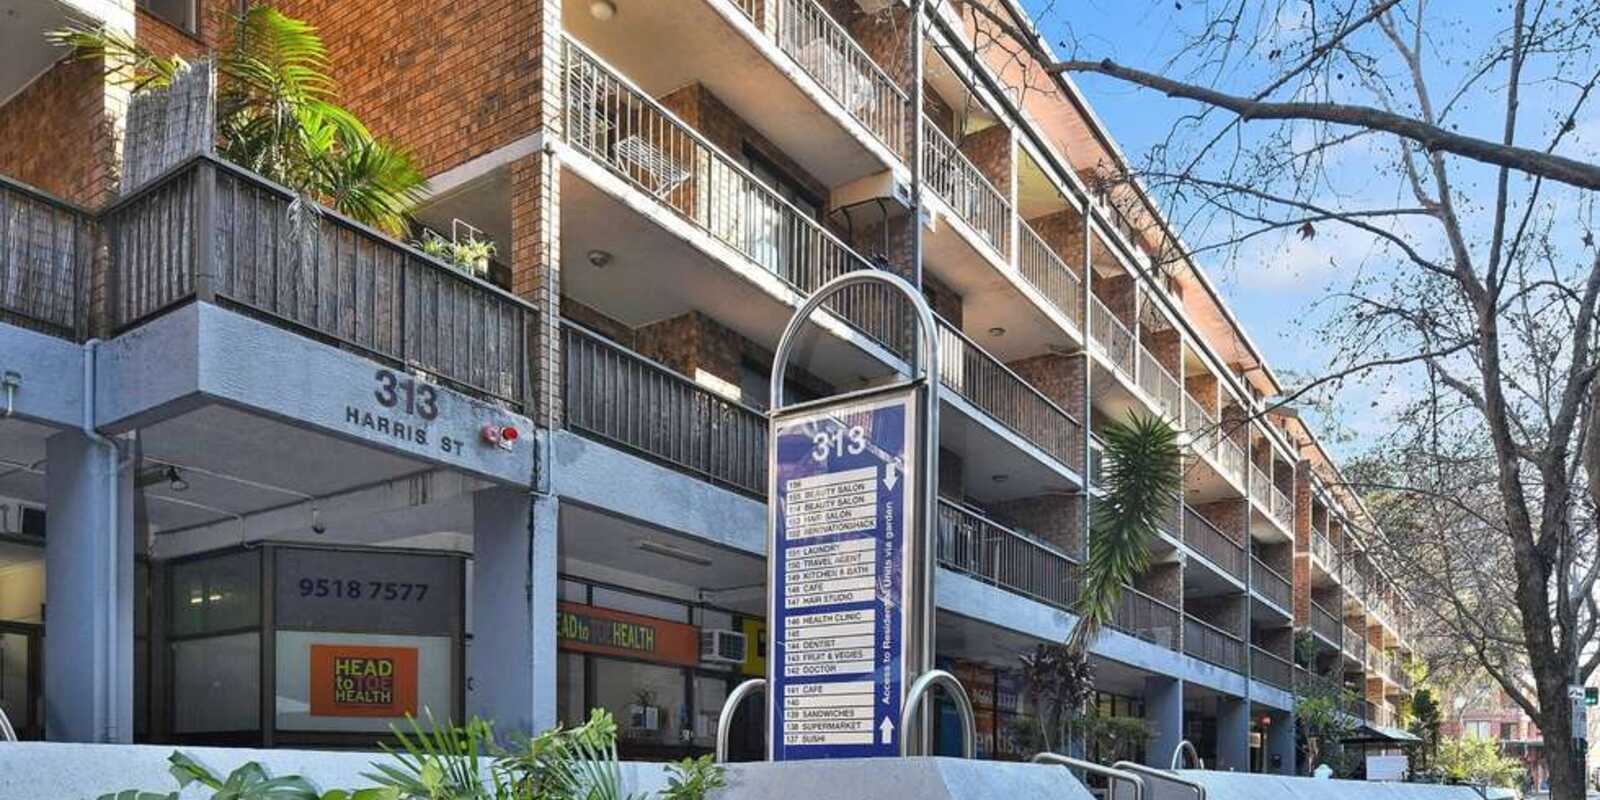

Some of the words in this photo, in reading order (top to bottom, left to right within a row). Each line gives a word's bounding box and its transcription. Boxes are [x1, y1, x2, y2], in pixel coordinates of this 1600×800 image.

[374, 369, 438, 421] 313
[346, 406, 427, 445] HARRIS
[441, 436, 465, 455] ST
[812, 426, 865, 461] 313
[805, 488, 836, 499] BEAUTY
[838, 483, 865, 492] SALON
[805, 500, 836, 511] BEAUTY
[838, 496, 865, 506] SALON
[826, 510, 852, 519] SALON
[885, 501, 894, 539] garden
[803, 544, 840, 556] LAUNDRY
[803, 558, 833, 567] TRAVEL
[834, 553, 861, 563] AGENT
[803, 569, 838, 579] KITCHEN
[847, 566, 869, 576] BATH
[884, 560, 892, 587] Units
[300, 578, 361, 599] 9518
[369, 582, 429, 601] 7577
[803, 583, 824, 592] CAFE
[803, 595, 822, 604] HAIR
[823, 592, 853, 602] STUDIO
[803, 614, 833, 624] HEALTH
[834, 612, 862, 621] CLINIC
[557, 611, 577, 639] EAD
[578, 619, 590, 641] to
[612, 622, 655, 652] HEALTH
[803, 639, 836, 649] DENTIST
[803, 652, 826, 661] FRUIT
[834, 649, 863, 659] VEGIES
[882, 652, 891, 663] to
[336, 658, 392, 676] HEAD
[803, 664, 837, 673] DOCTOR
[336, 676, 354, 690] to
[356, 676, 392, 691] TOE
[803, 685, 823, 693] CAFE
[881, 666, 891, 705] Access
[336, 690, 392, 703] HEALTH
[803, 709, 855, 718] SANDWICHES
[802, 721, 862, 730] SUPERMARKET
